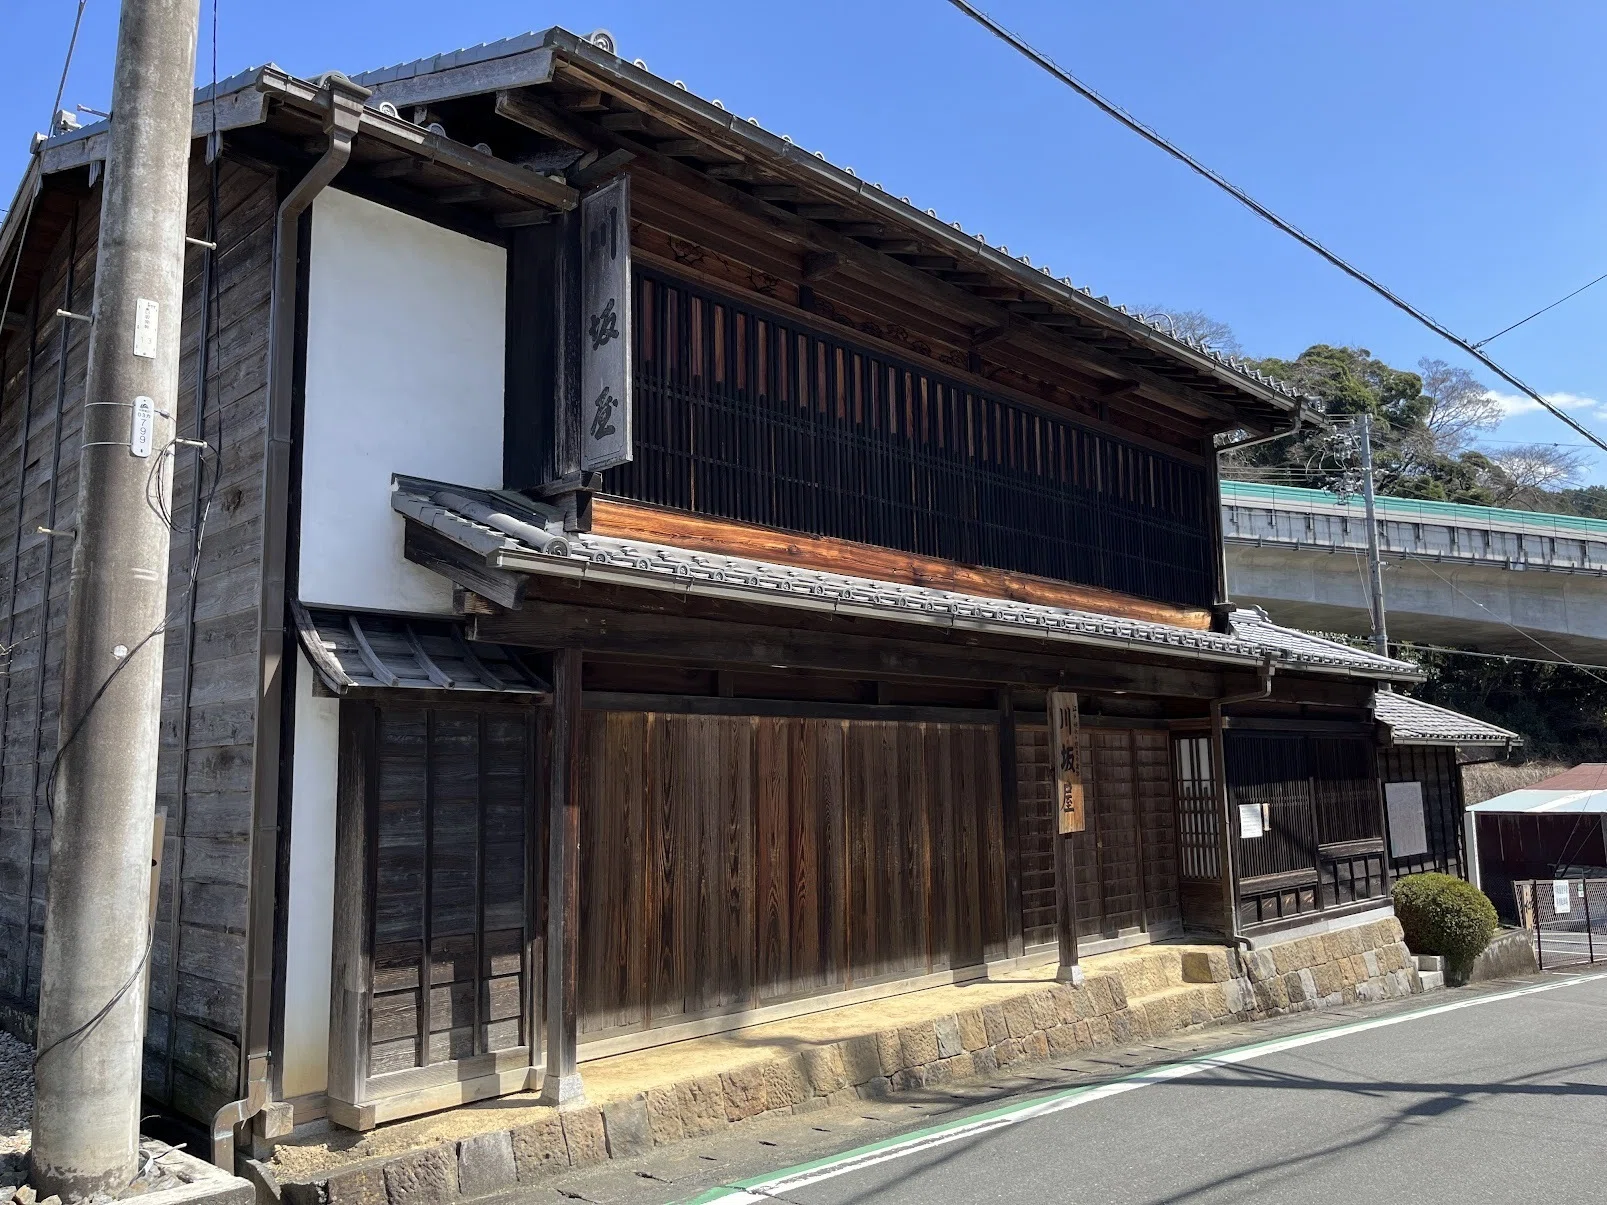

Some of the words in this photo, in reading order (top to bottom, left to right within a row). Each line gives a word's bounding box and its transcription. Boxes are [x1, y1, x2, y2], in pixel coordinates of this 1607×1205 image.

[589, 205, 620, 441] 川坂屋
[1059, 707, 1075, 813] 川坂屋
